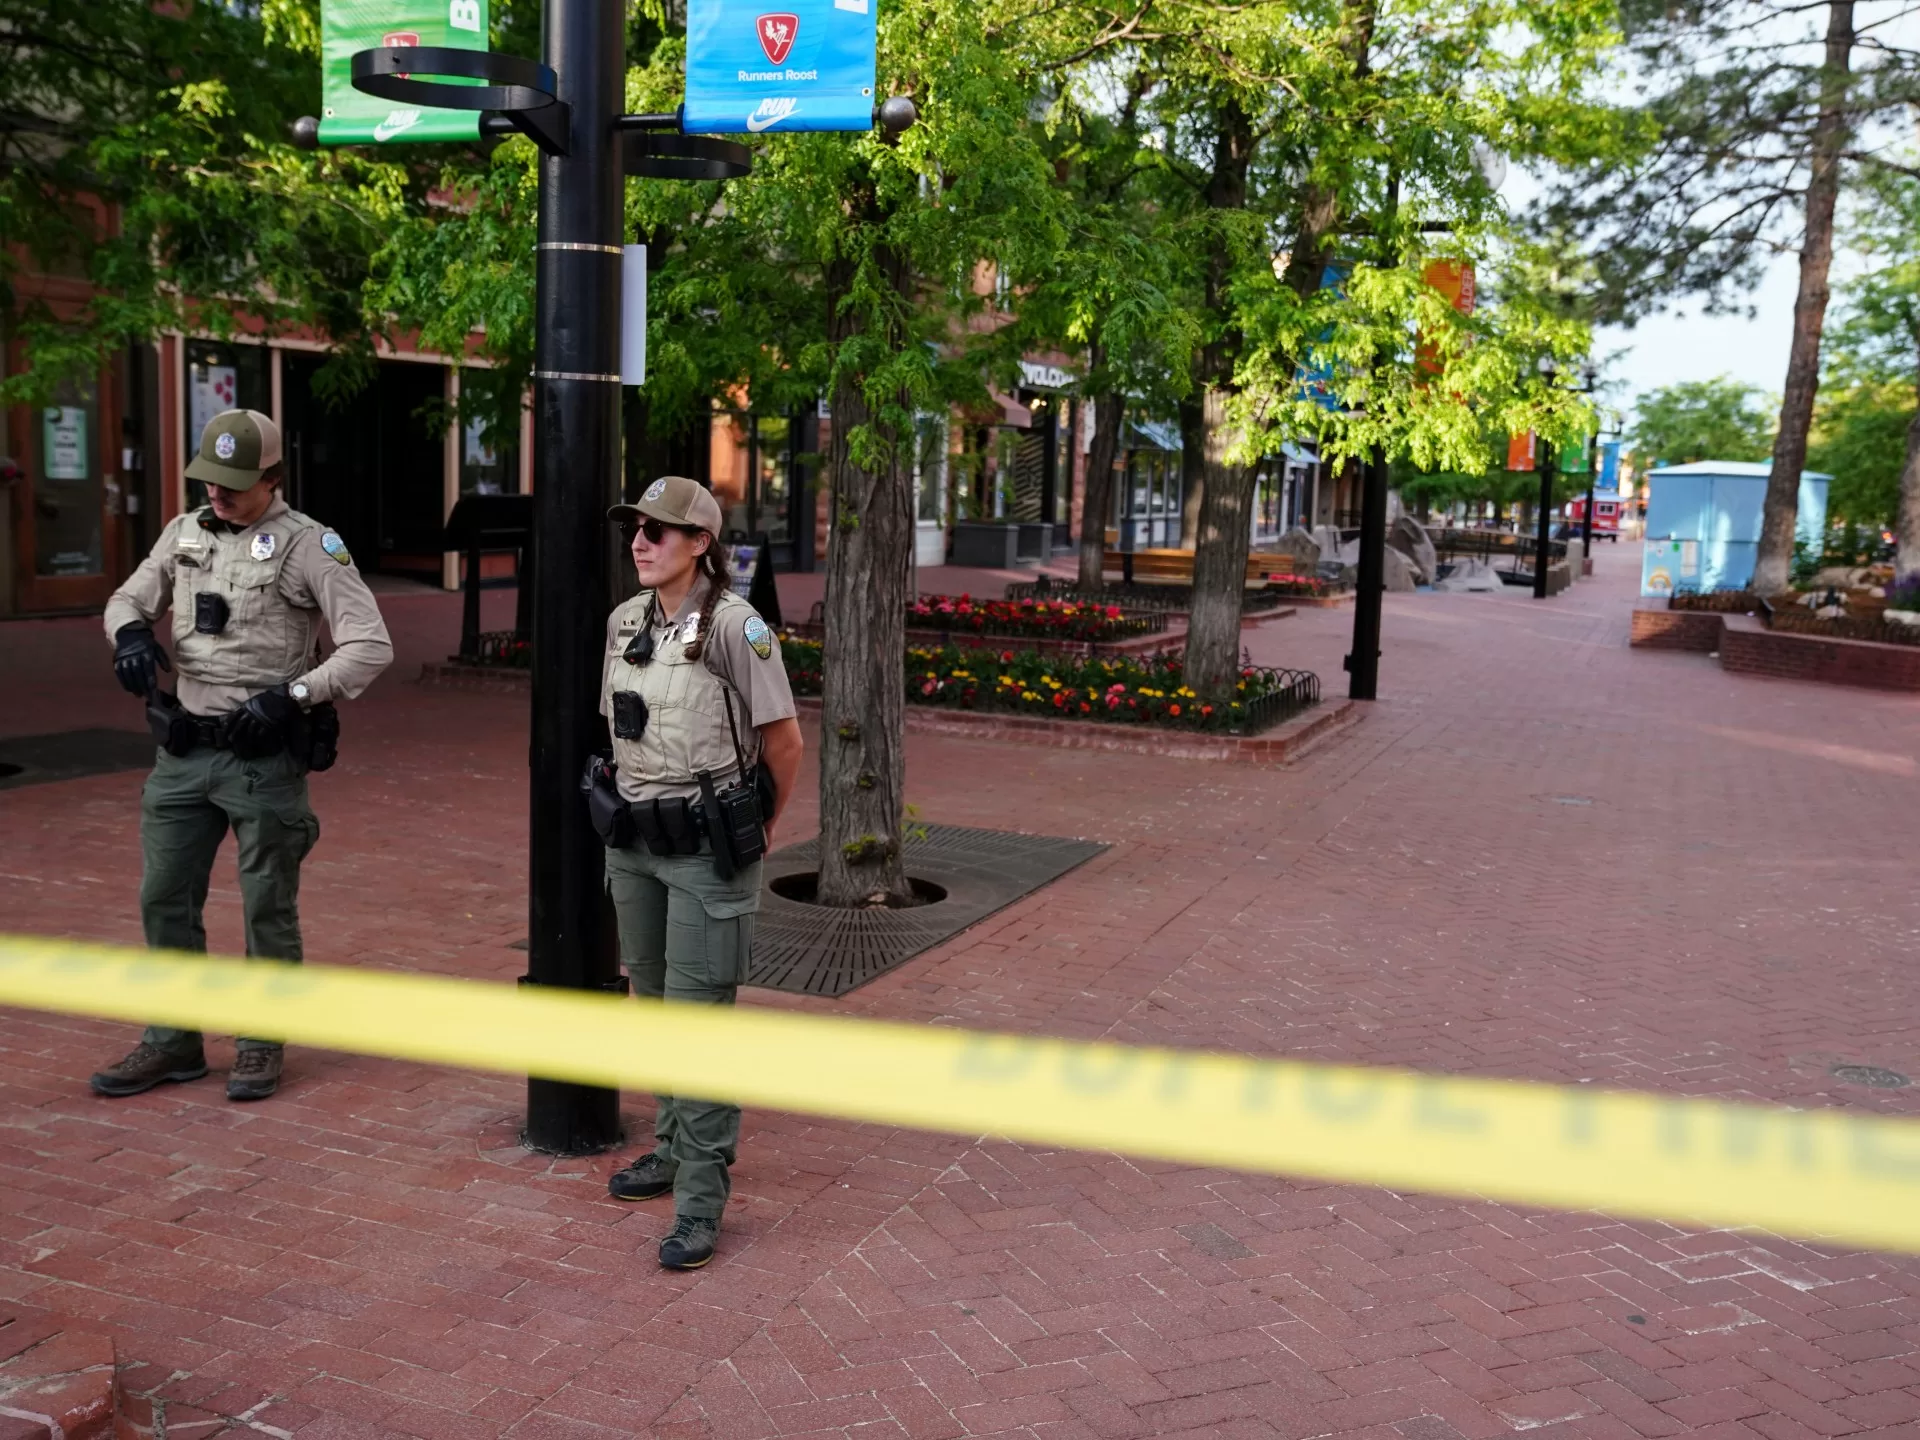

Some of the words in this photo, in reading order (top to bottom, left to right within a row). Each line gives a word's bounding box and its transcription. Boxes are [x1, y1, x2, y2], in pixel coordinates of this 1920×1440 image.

[738, 70, 783, 81] Runners
[786, 69, 818, 80] Roost
[756, 97, 797, 115] RUN
